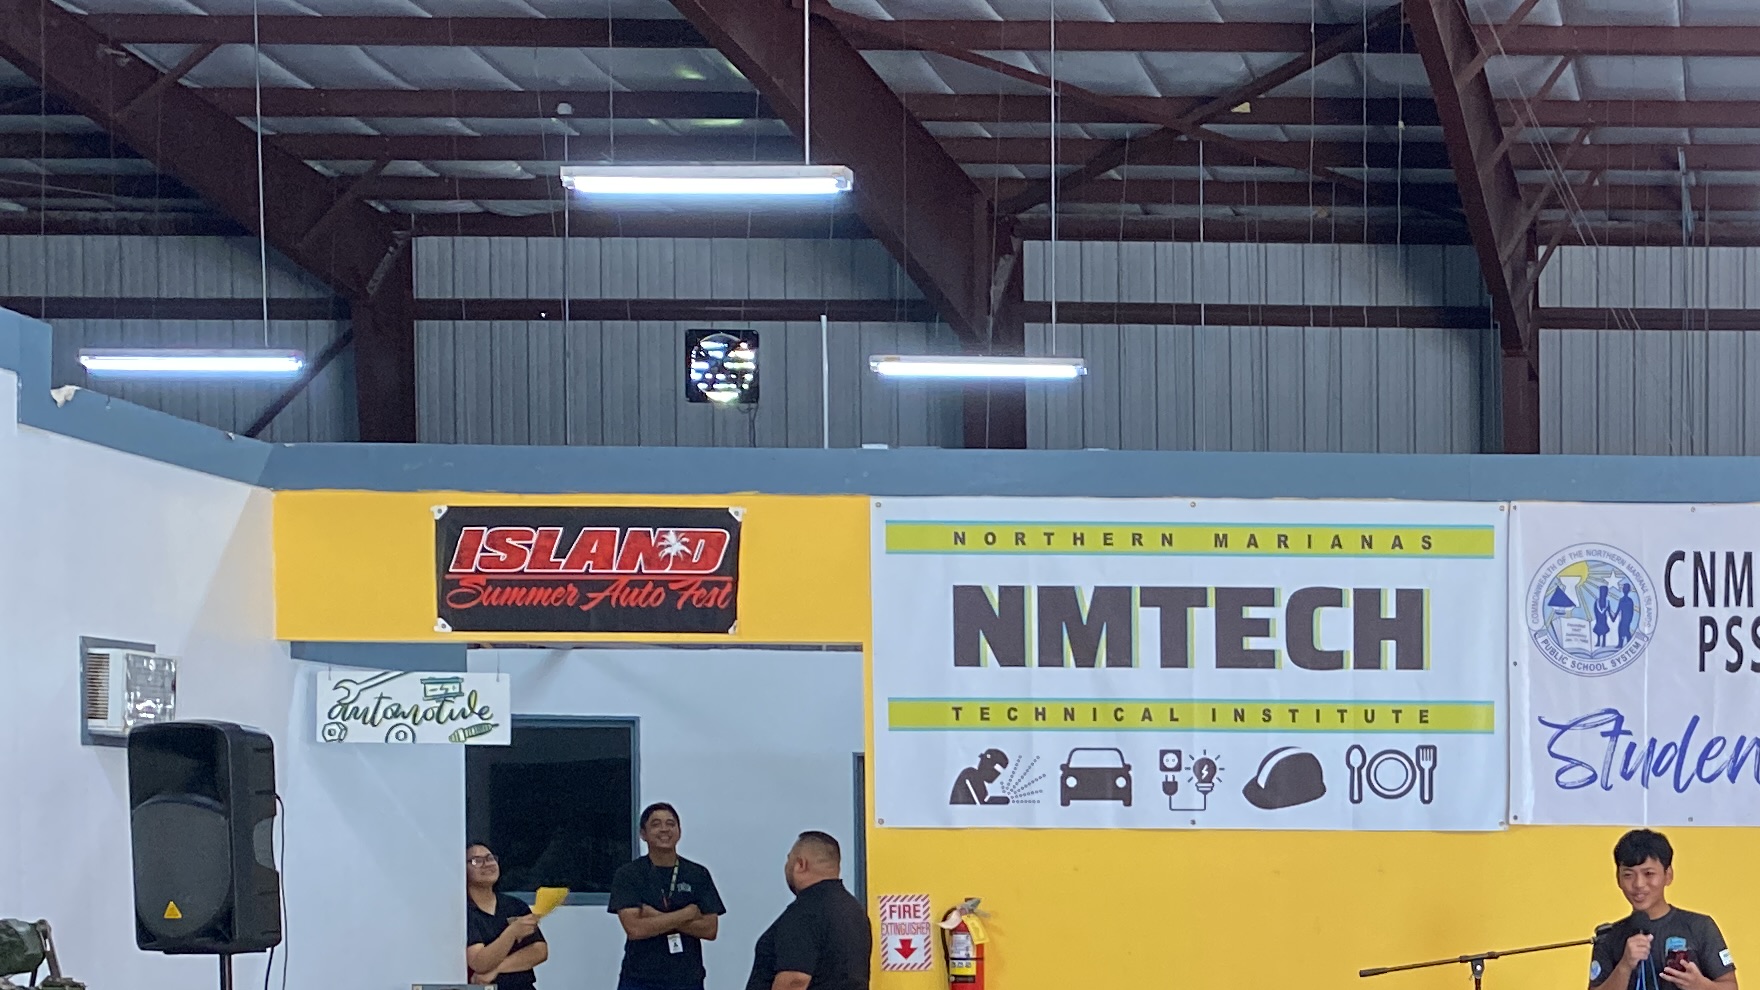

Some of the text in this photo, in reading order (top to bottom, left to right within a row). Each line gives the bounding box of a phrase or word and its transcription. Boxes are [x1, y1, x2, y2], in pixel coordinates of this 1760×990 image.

[449, 527, 731, 573] ISLAND
[953, 531, 1434, 550] NORTHERN MARIANAS
[1569, 550, 1583, 560] THE
[1585, 549, 1628, 568] NORTHERN
[446, 576, 732, 611] Summer Auto Fest
[953, 585, 1431, 671] NMTECH
[1540, 637, 1642, 672] PUBLIC SCHOOL SYSTEM
[952, 707, 1431, 725] TECHNICAL INSTITUTE
[889, 904, 922, 919] FIRE
[881, 922, 930, 936] EXTINGUISHER
